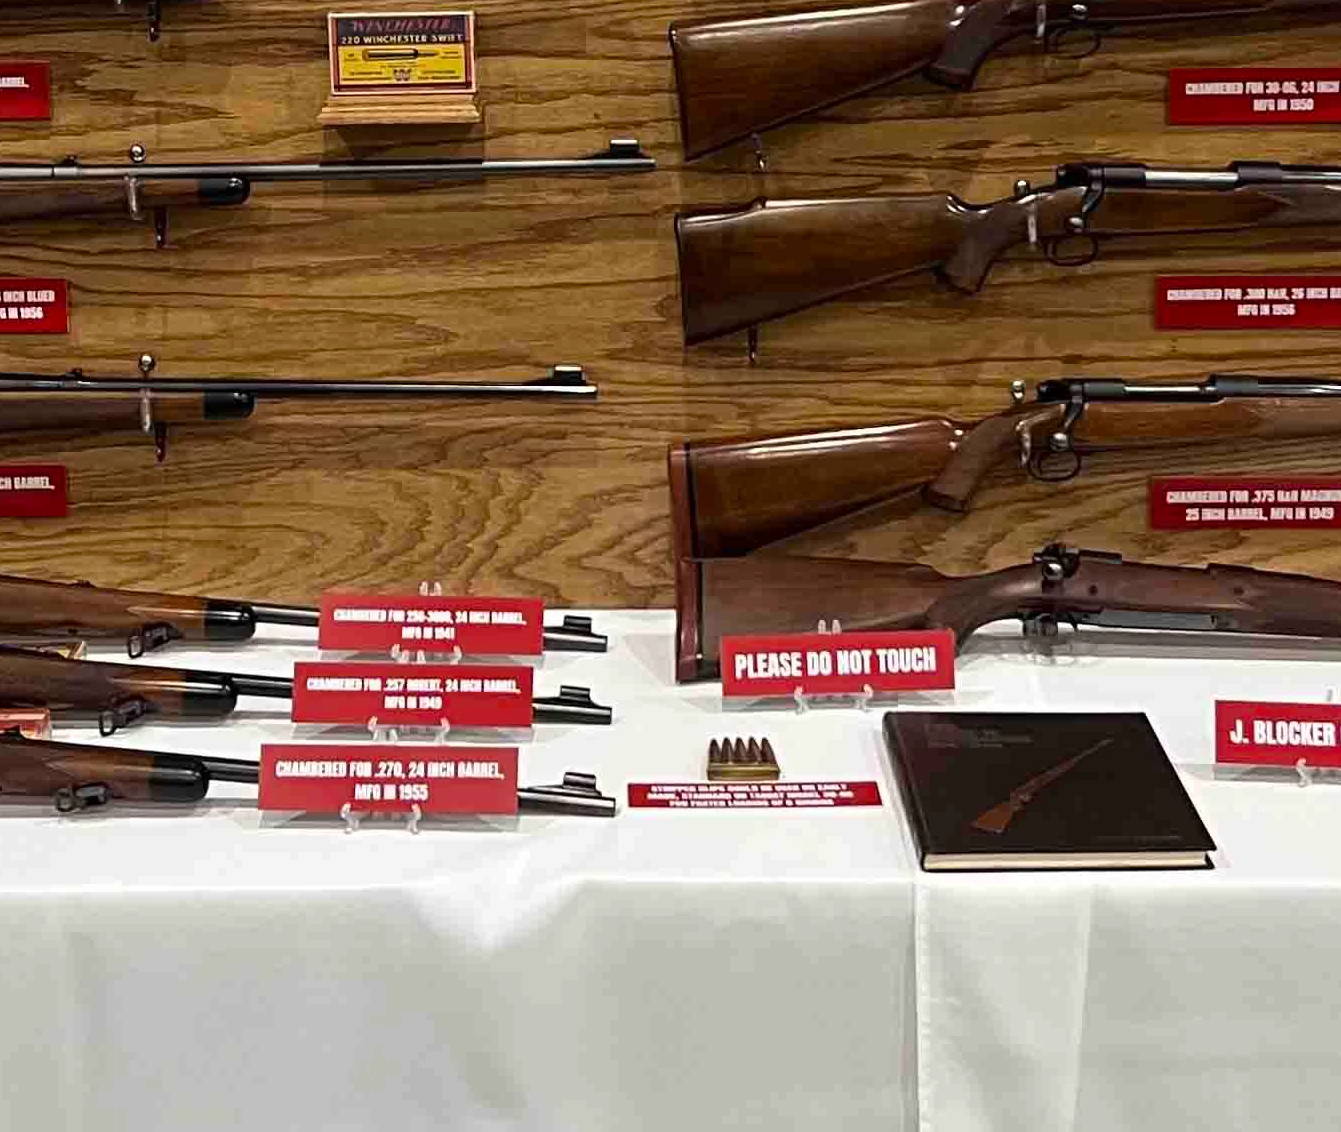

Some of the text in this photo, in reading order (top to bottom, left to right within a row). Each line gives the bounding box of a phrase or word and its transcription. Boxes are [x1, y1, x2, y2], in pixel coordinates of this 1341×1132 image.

[363, 34, 427, 45] WINCHESTER
[734, 646, 937, 680] PLEASE DO NOT TOUCH
[1230, 719, 1250, 744] J.
[1254, 720, 1335, 747] BLOCKER
[275, 760, 348, 778] CHAMBERED
[348, 760, 373, 778] FOR
[409, 760, 426, 779] 24
[426, 761, 456, 779] INCH
[354, 783, 381, 801] MFG
[383, 783, 397, 801] IN
